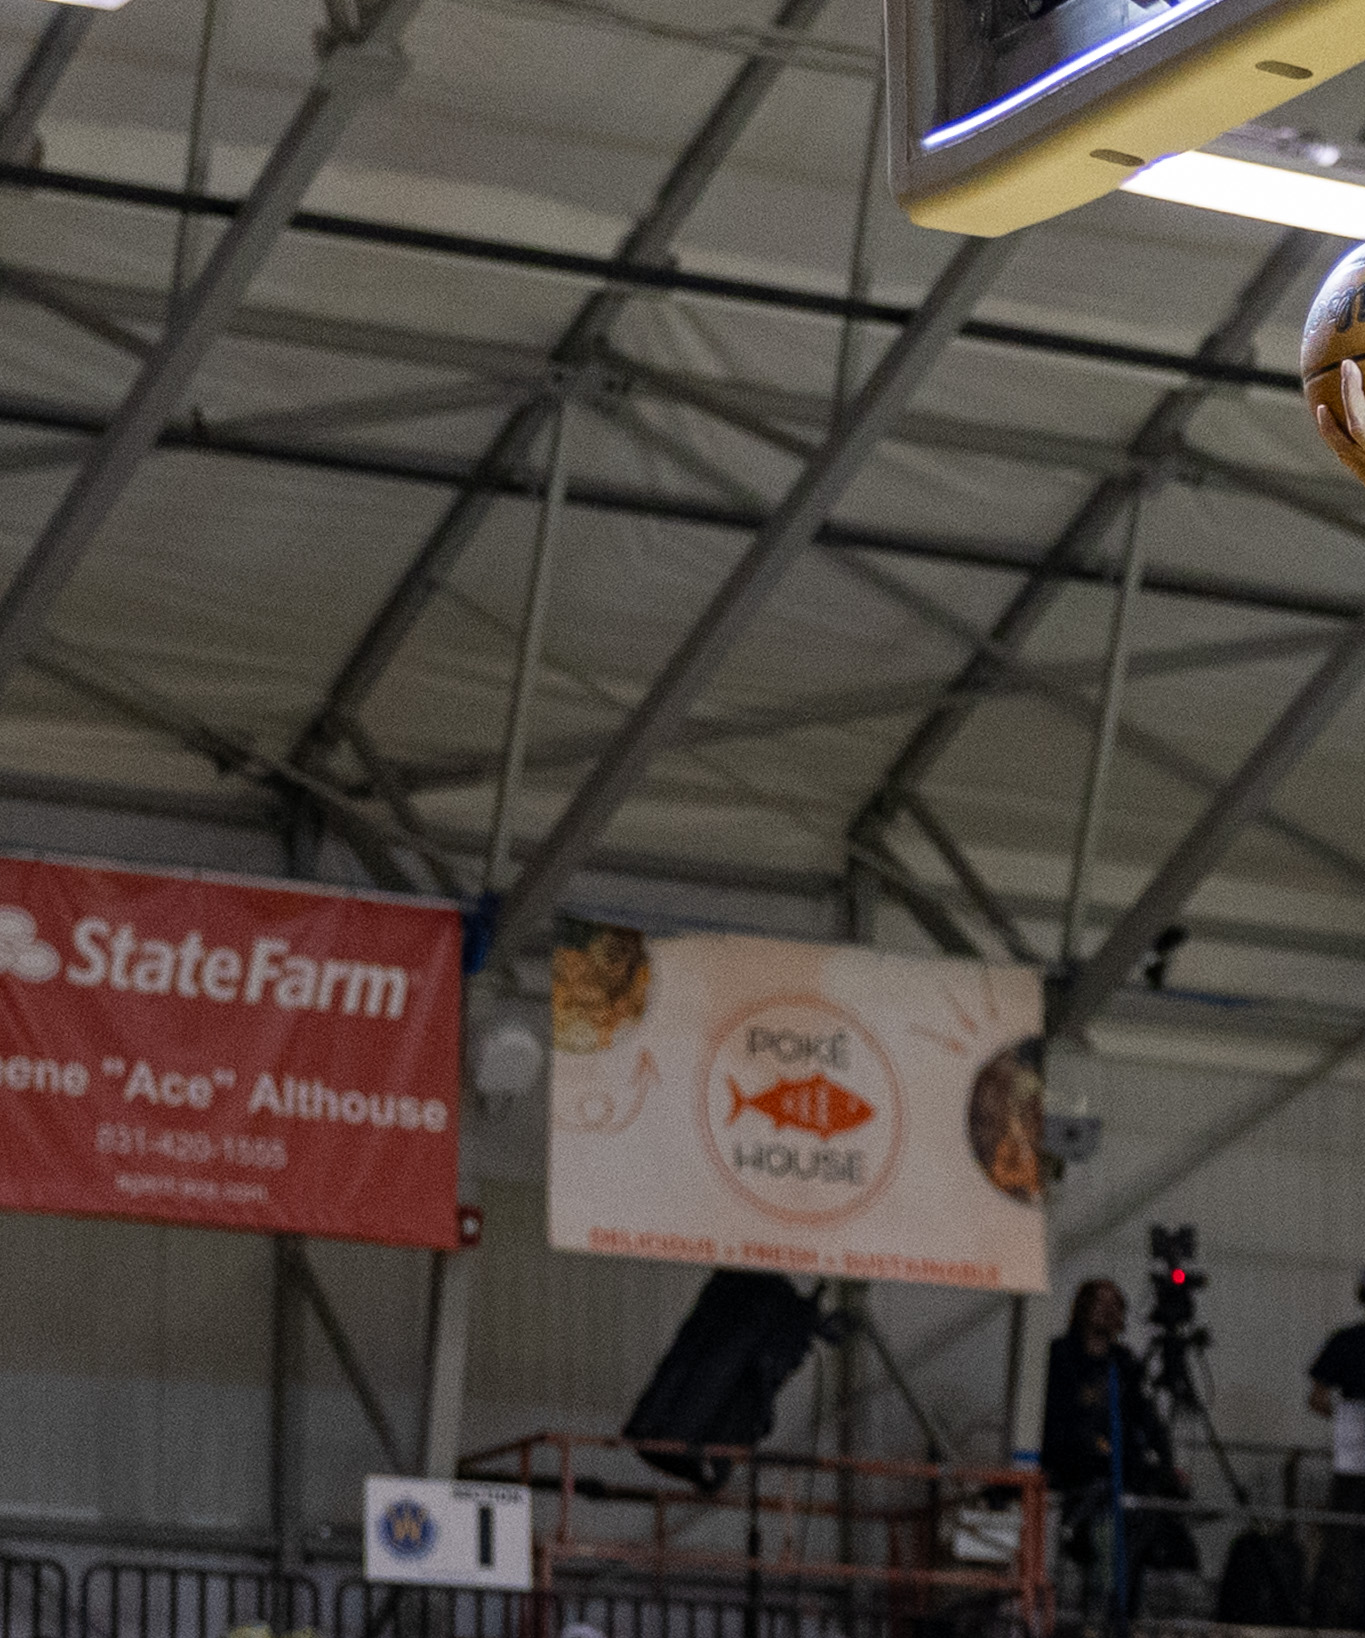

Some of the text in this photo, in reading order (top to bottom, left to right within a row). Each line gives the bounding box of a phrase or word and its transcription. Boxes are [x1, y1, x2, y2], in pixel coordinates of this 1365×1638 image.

[745, 1026, 850, 1071] POKÉ
[103, 1057, 237, 1109] "Ace"
[247, 1073, 448, 1132] Althouse
[730, 1141, 868, 1186] HOUSE
